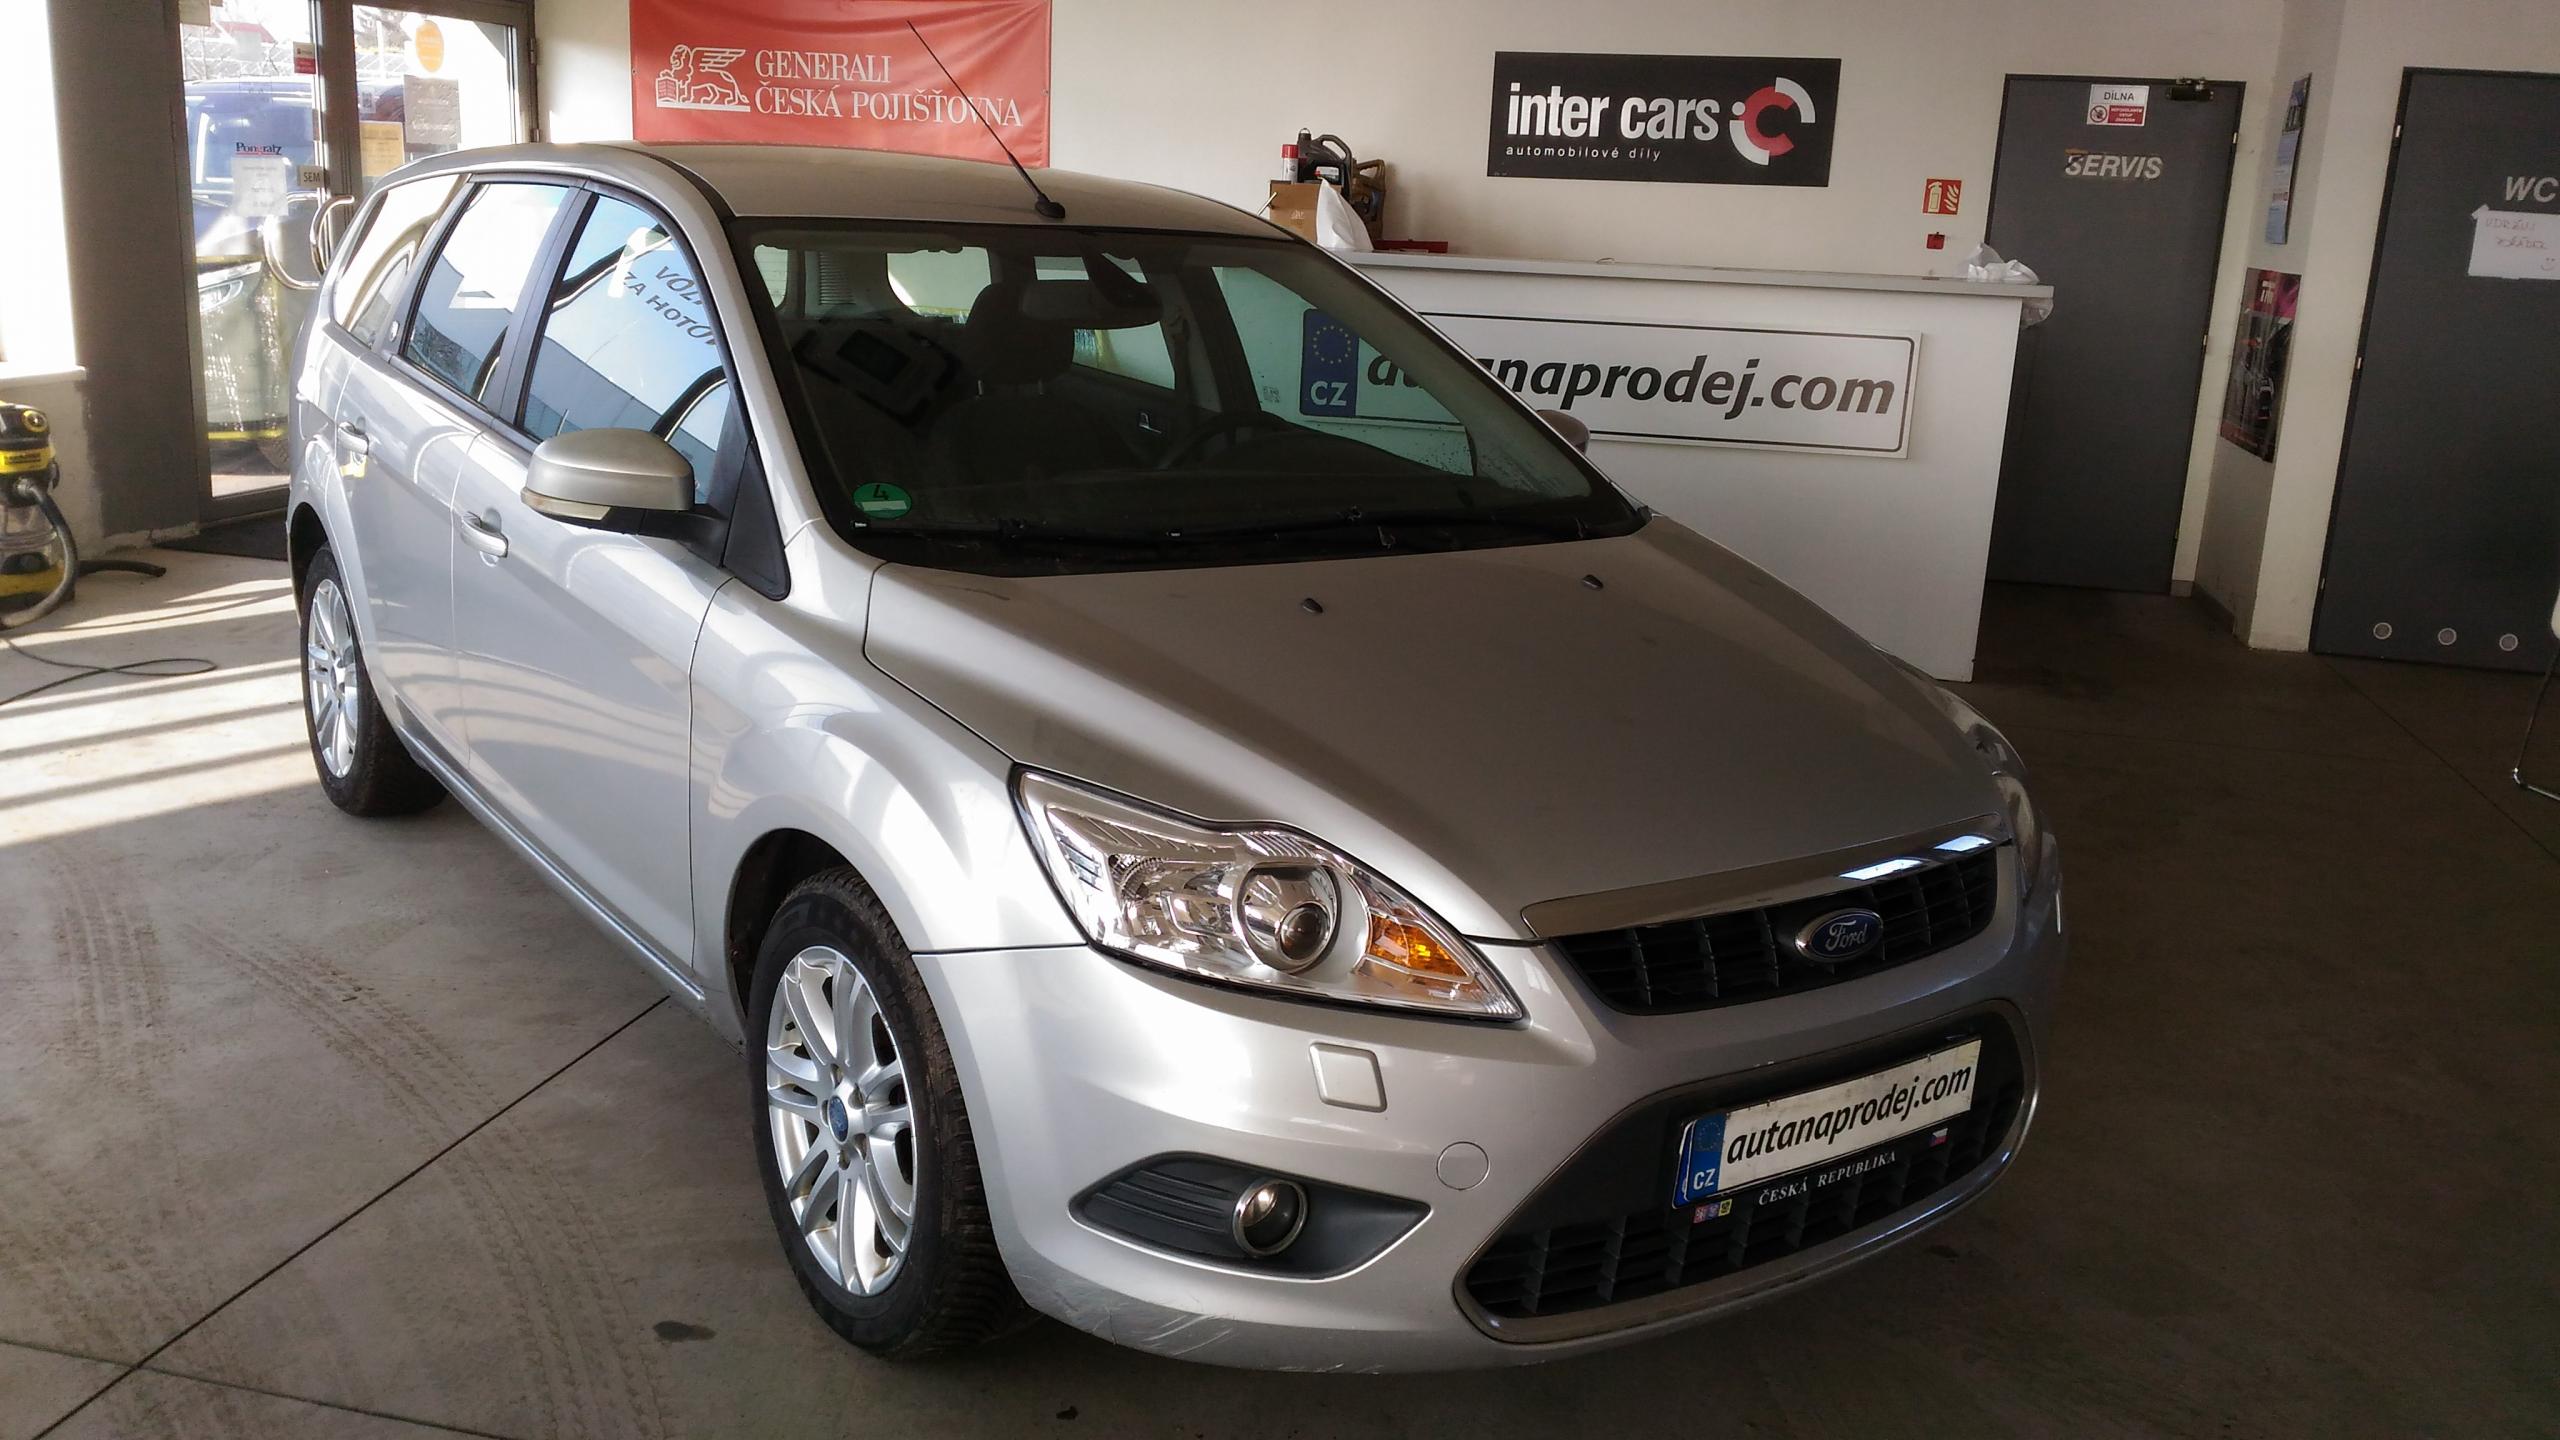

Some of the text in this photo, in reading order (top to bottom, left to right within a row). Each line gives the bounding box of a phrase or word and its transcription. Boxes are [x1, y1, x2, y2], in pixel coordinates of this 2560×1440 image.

[755, 49, 892, 84] GENERALI
[755, 81, 1023, 127] ČESKÁ POJIŠŤOVNA
[2104, 89, 2135, 101] DÍLNA
[1507, 82, 1720, 142] inter cars
[1506, 145, 1661, 163] automobilové díly
[2065, 154, 2164, 180] SERVIS
[2505, 176, 2559, 203] WC
[1310, 380, 1349, 407] CZ
[873, 485, 889, 500] 4
[1825, 920, 1868, 951] Ford
[1727, 1066, 1972, 1165] autanaprodej.com
[1693, 1168, 1715, 1191] CZ
[1759, 1151, 1897, 1206] ČESKÁ REPUBLIKA
